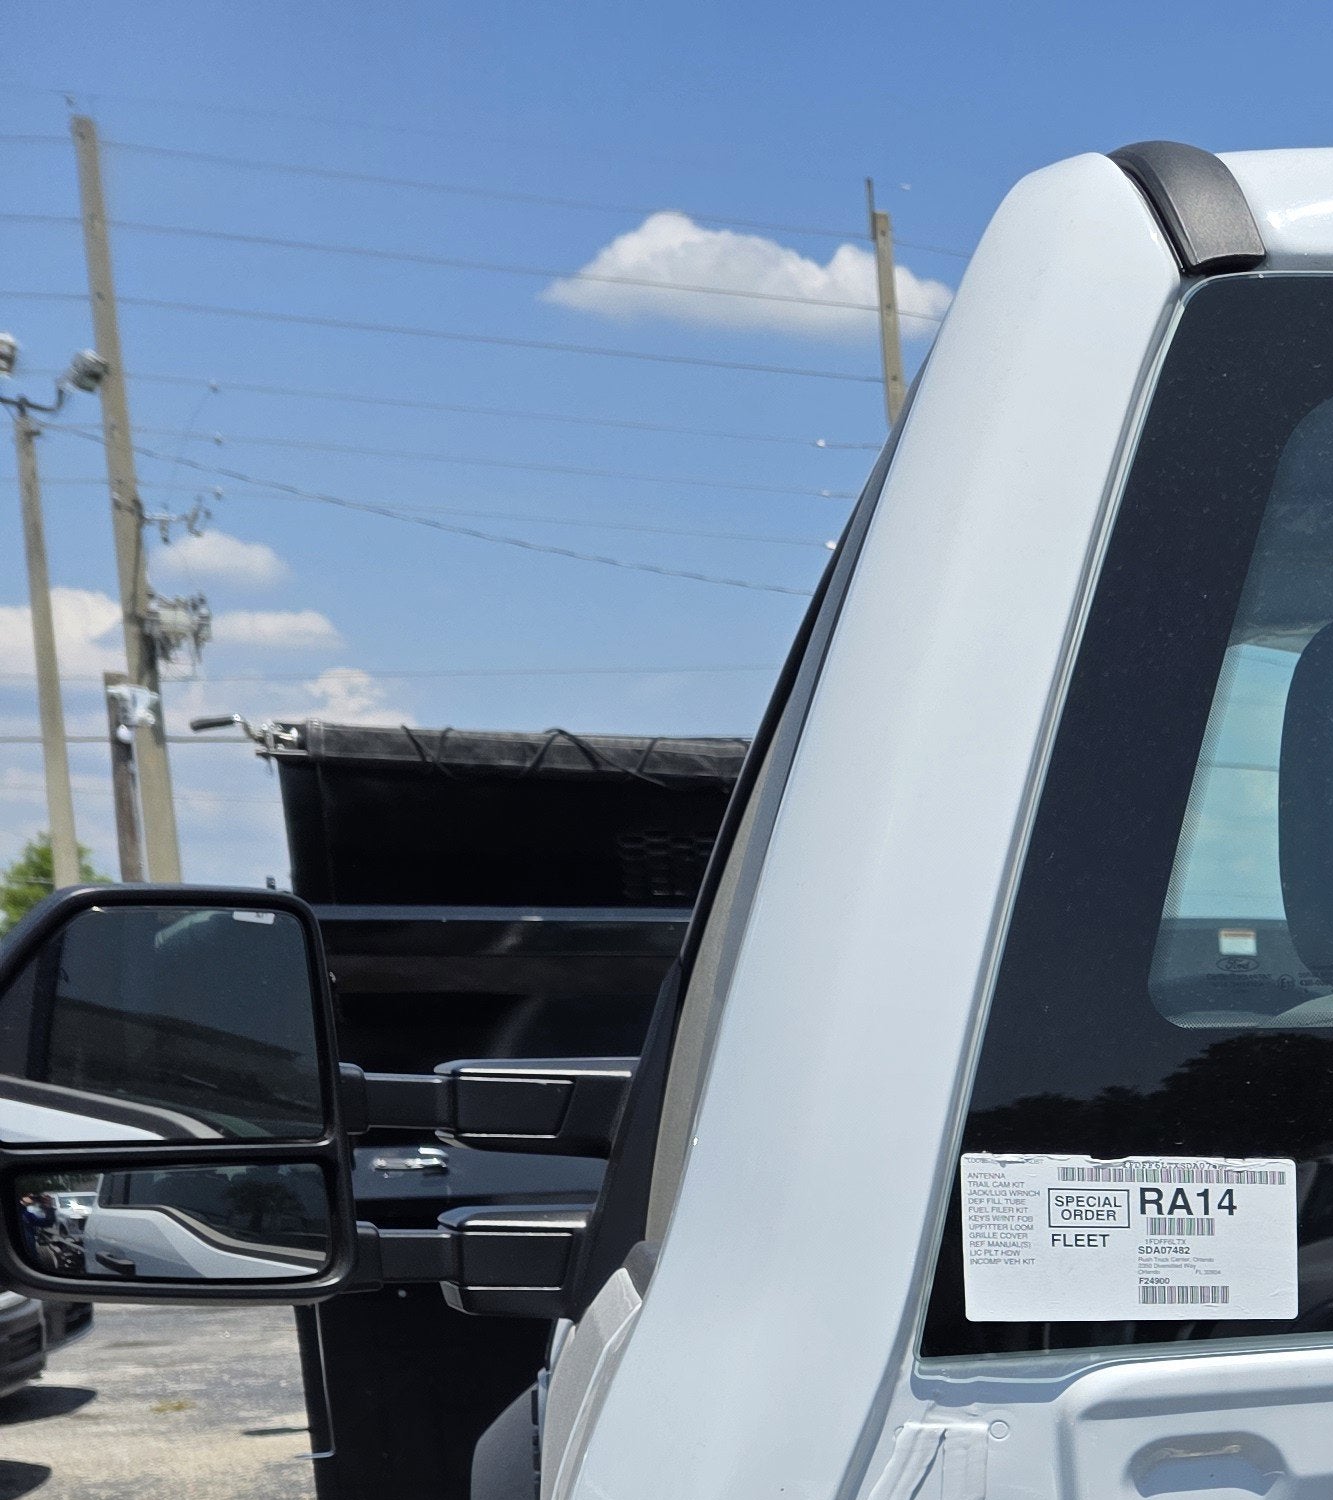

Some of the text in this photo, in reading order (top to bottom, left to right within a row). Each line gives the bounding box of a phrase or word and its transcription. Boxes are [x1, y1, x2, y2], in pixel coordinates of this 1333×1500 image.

[1054, 1195, 1122, 1208] SPECIAL
[1140, 1187, 1237, 1216] RA14
[1061, 1209, 1117, 1221] ORDER
[1051, 1233, 1110, 1247] FLEET
[1138, 1277, 1170, 1285] F24900
